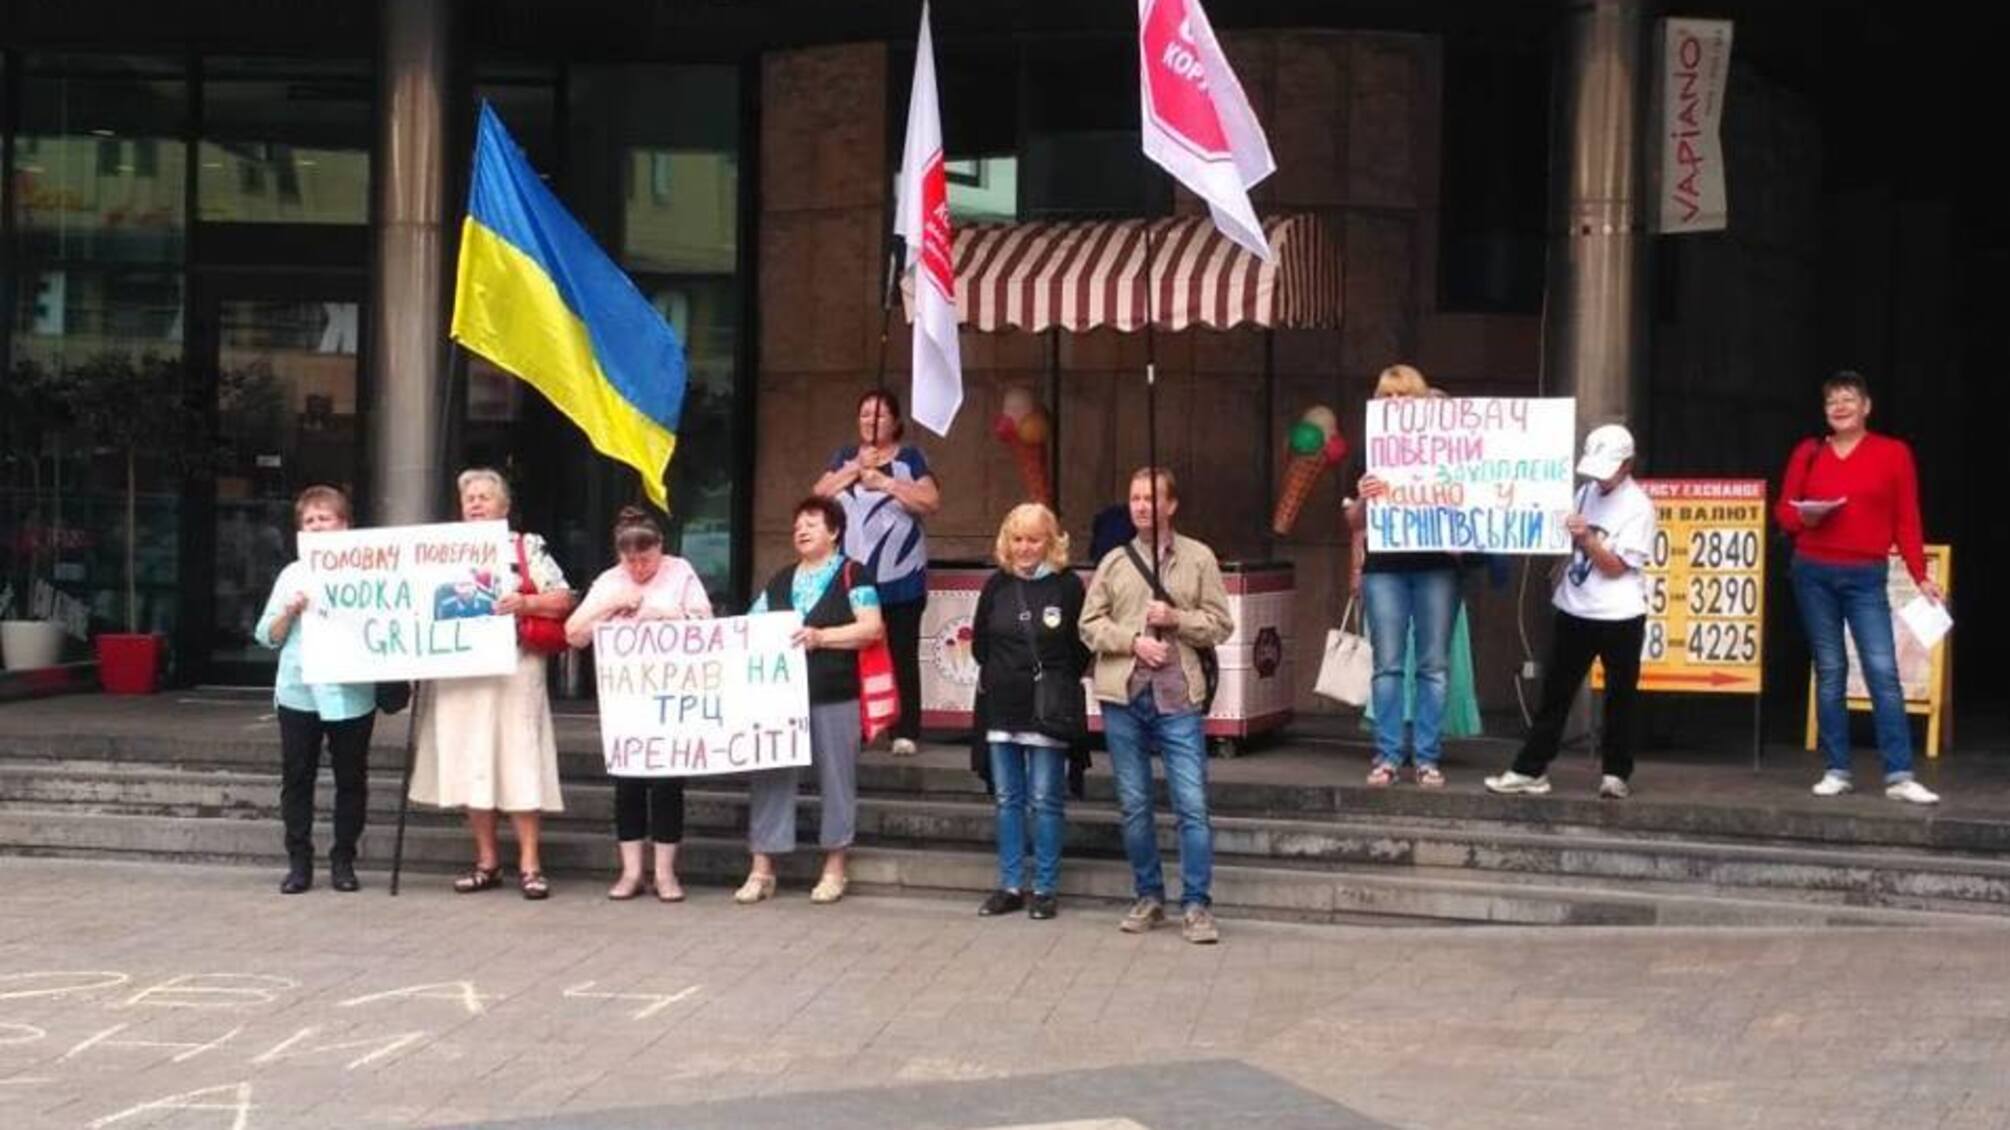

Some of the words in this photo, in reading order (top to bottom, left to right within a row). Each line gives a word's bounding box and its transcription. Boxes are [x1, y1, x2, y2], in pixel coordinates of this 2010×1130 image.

[1382, 399, 1528, 433] ГОЛОВАЧ
[1371, 435, 1484, 468] ПОВЕРНИ
[1684, 484, 1760, 497] EXCHANGE
[1679, 506, 1758, 521] ВАЛЮТ
[310, 547, 400, 571] ГОЛОВАЧ
[414, 541, 497, 564] ПОВЕРНИ
[1690, 531, 1758, 568] 2840
[1690, 577, 1757, 614] 3290
[598, 622, 748, 657] ГОЛОВАЧ
[1689, 623, 1757, 662] 4225
[600, 661, 722, 695] НАКРАВ
[748, 653, 789, 684] НА
[653, 695, 723, 726] ТРЦ
